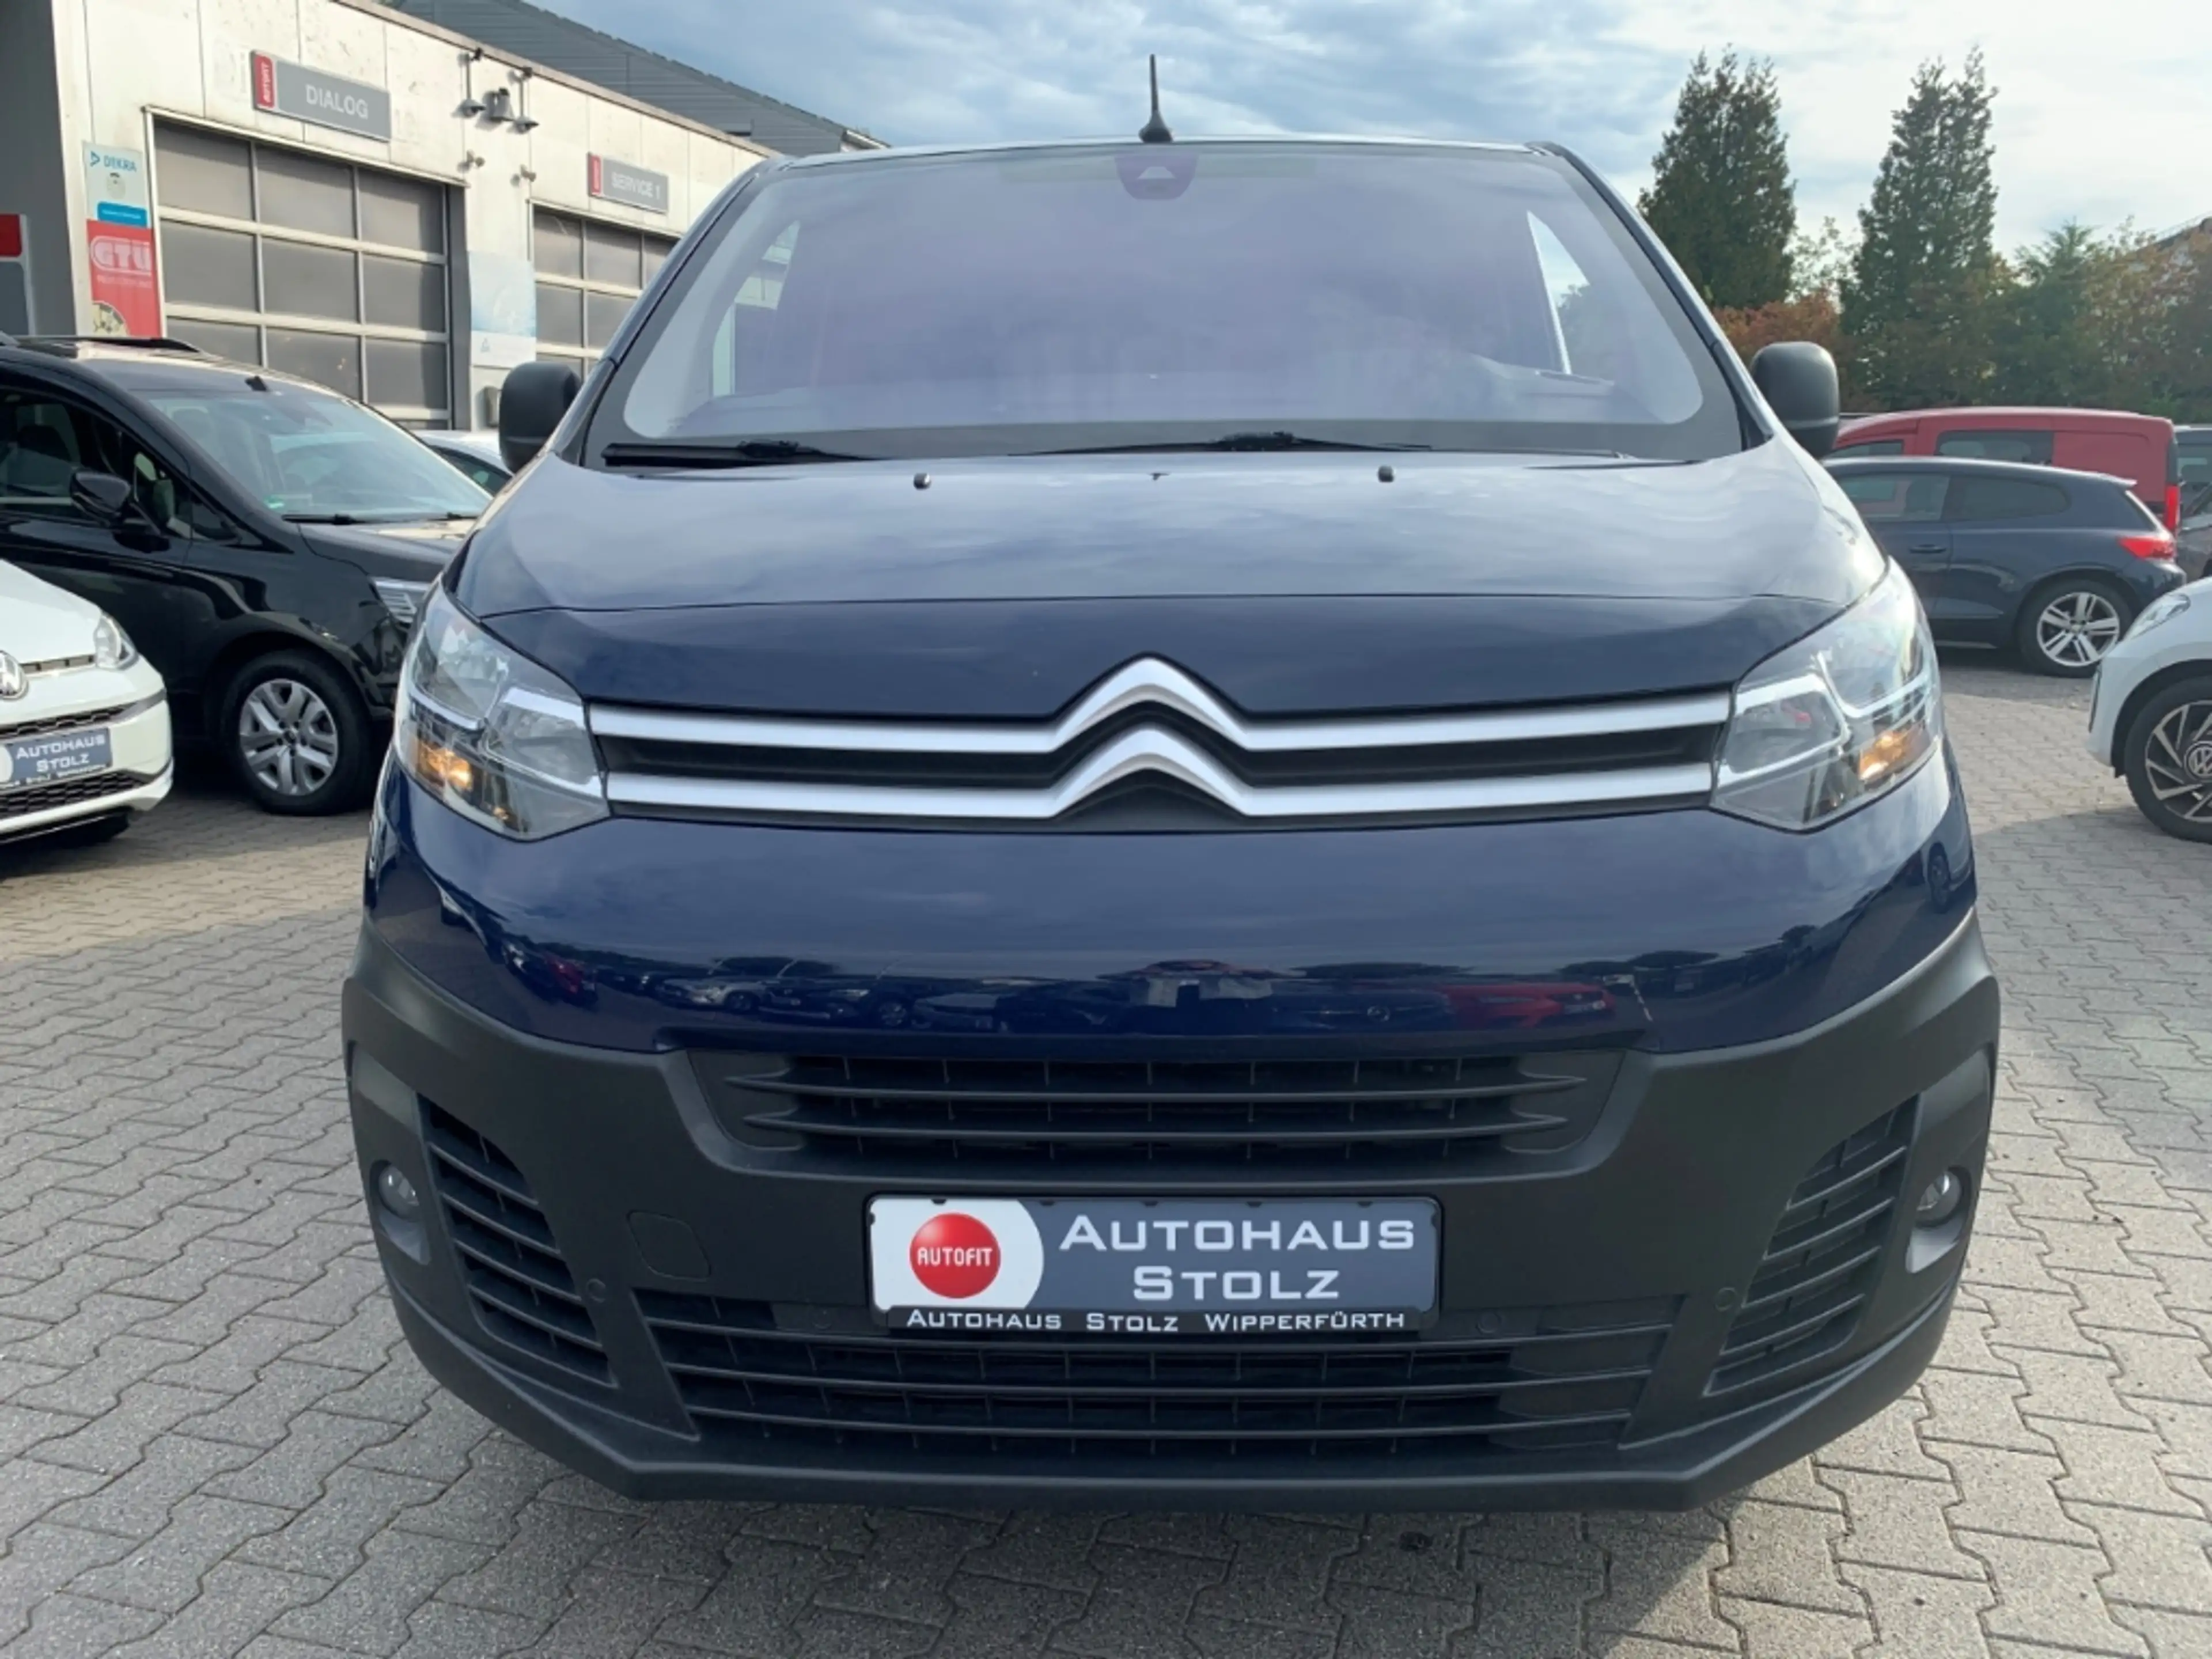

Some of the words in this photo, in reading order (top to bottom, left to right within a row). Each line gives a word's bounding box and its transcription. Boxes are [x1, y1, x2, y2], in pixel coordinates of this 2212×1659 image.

[305, 84, 369, 120] DIALOG
[16, 734, 105, 759] AUTOHAUS
[36, 752, 89, 772] STOLZ
[1059, 1214, 1415, 1251] AUTOHAUS
[917, 1247, 993, 1266] AUTOFIT
[1133, 1266, 1339, 1301] STOLZ
[907, 1309, 1062, 1330] AUTOHAUS
[1086, 1312, 1179, 1332] STOLZ
[1205, 1312, 1404, 1331] WIPPERFÜRTH
